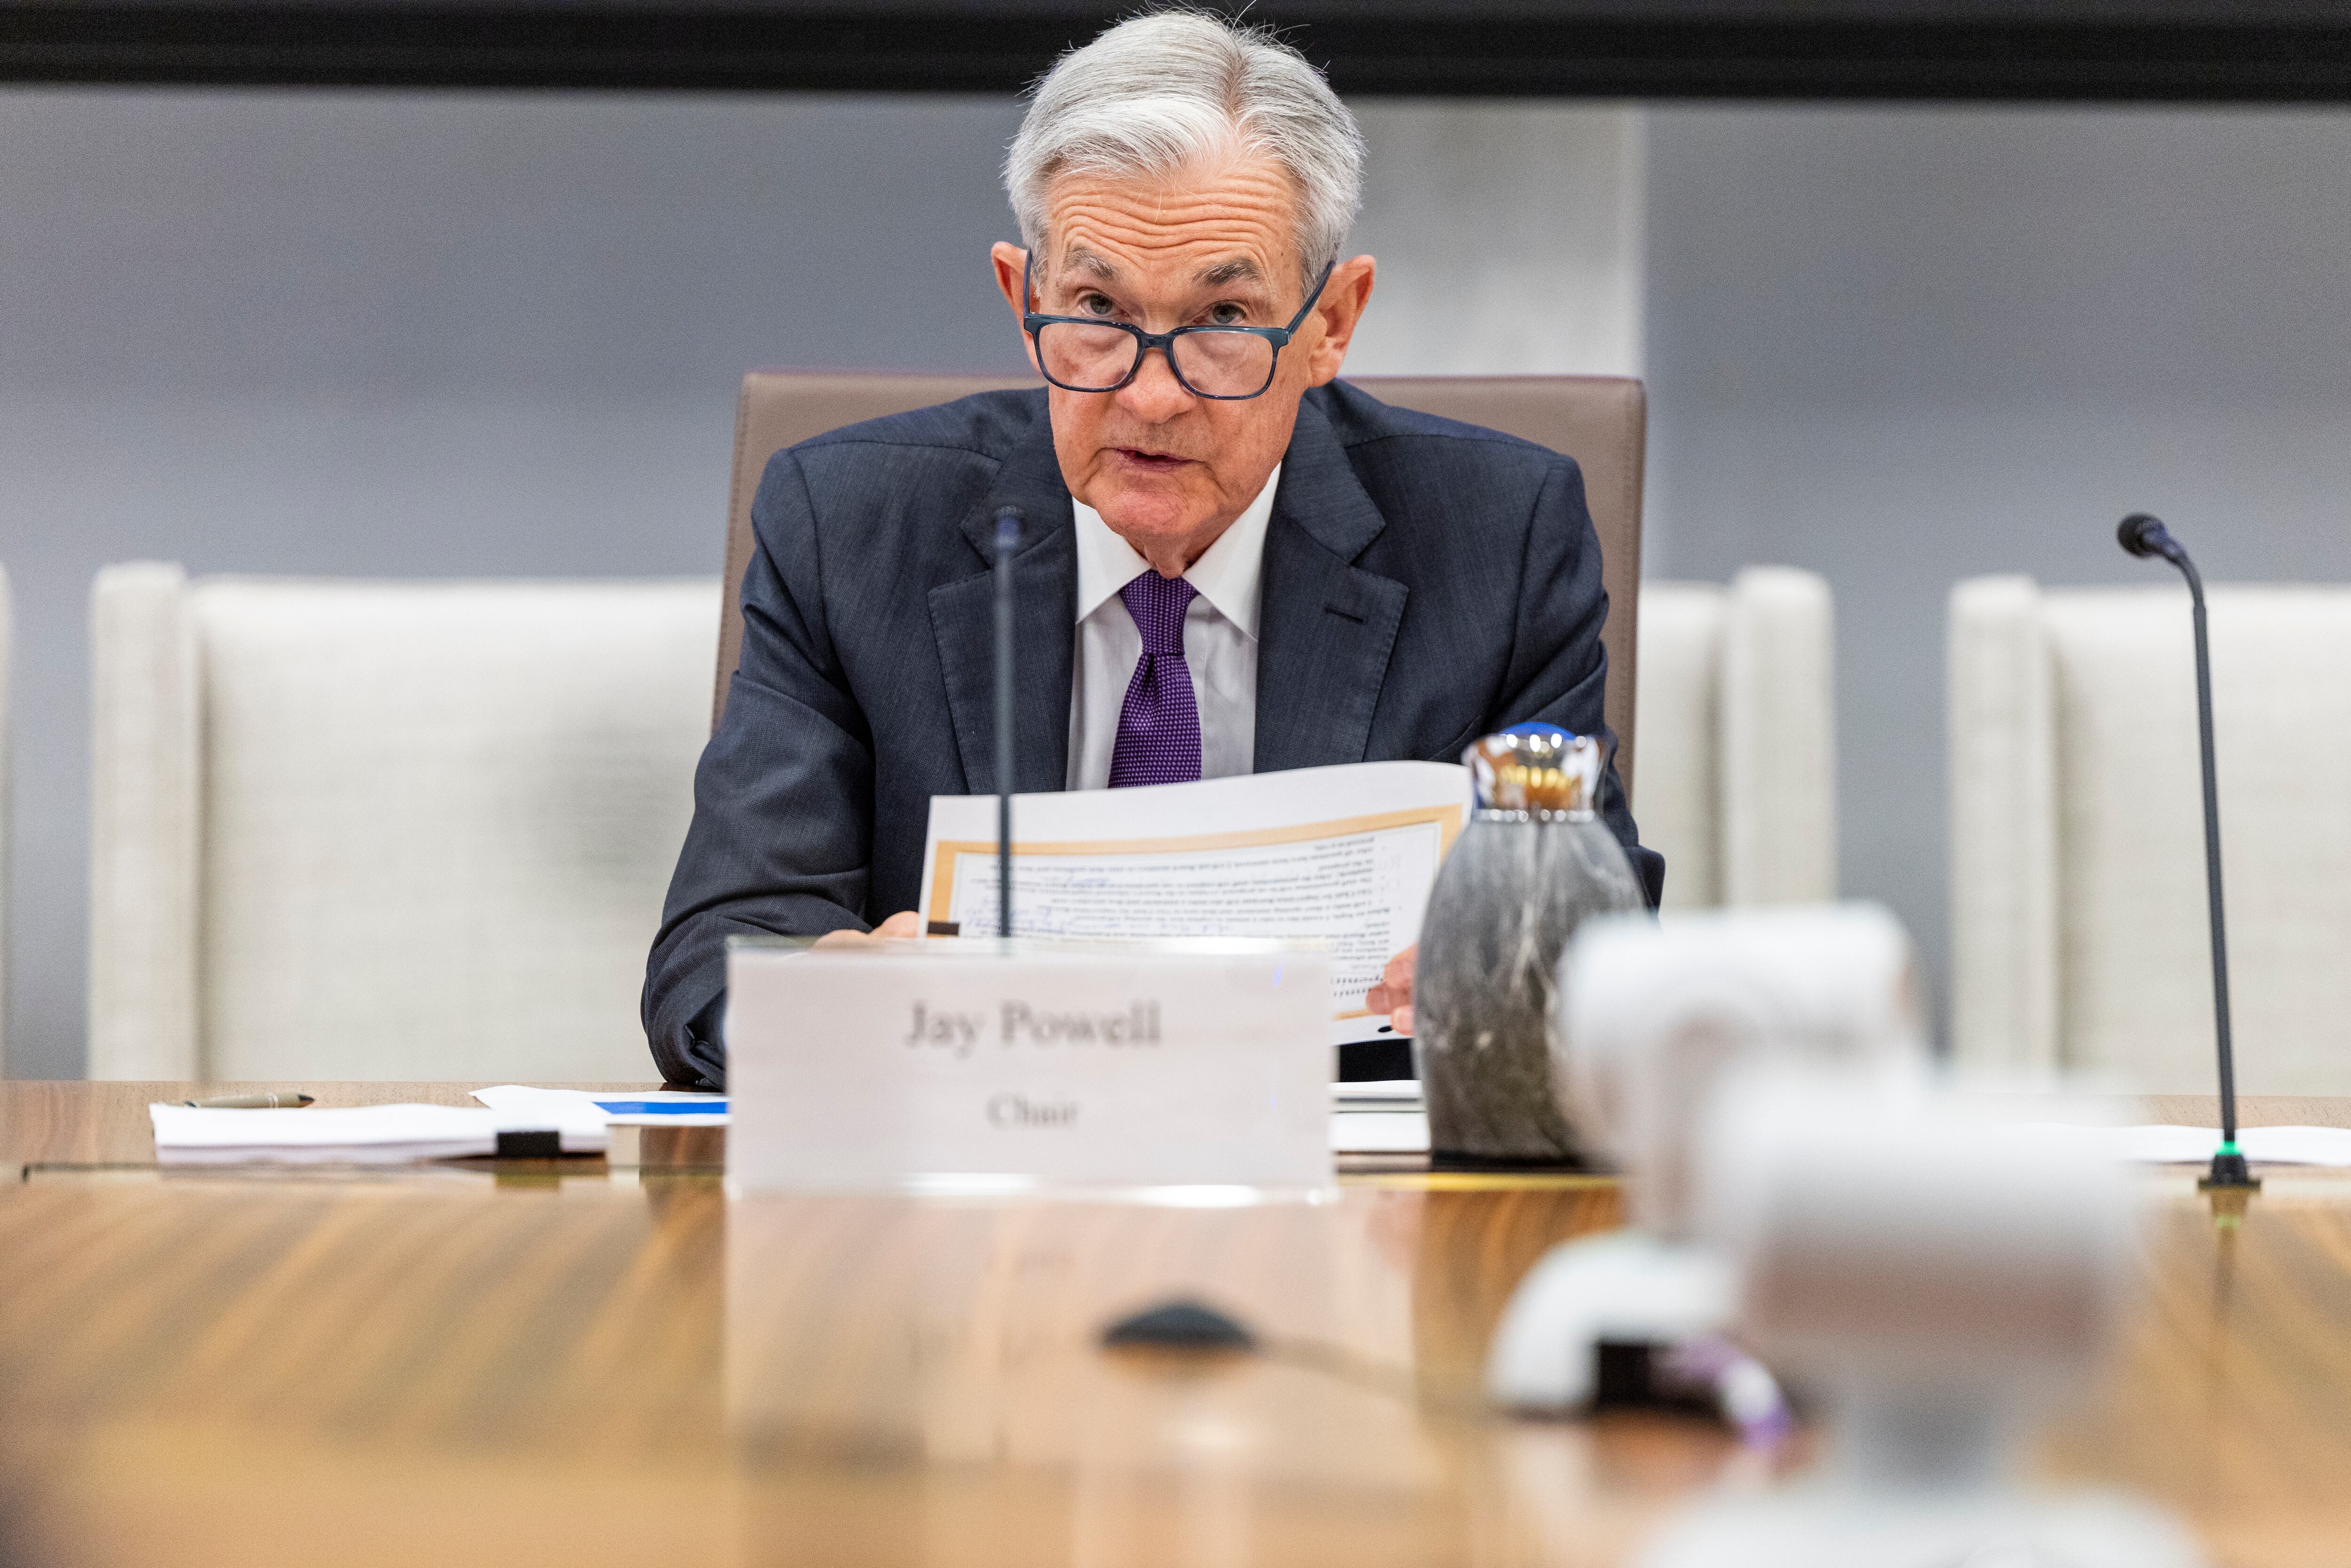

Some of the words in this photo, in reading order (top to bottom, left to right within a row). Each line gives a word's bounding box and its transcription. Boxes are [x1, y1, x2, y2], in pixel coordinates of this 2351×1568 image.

[904, 998, 986, 1058] Jay
[999, 998, 1163, 1048] Powell
[986, 1092, 1079, 1129] Chair
